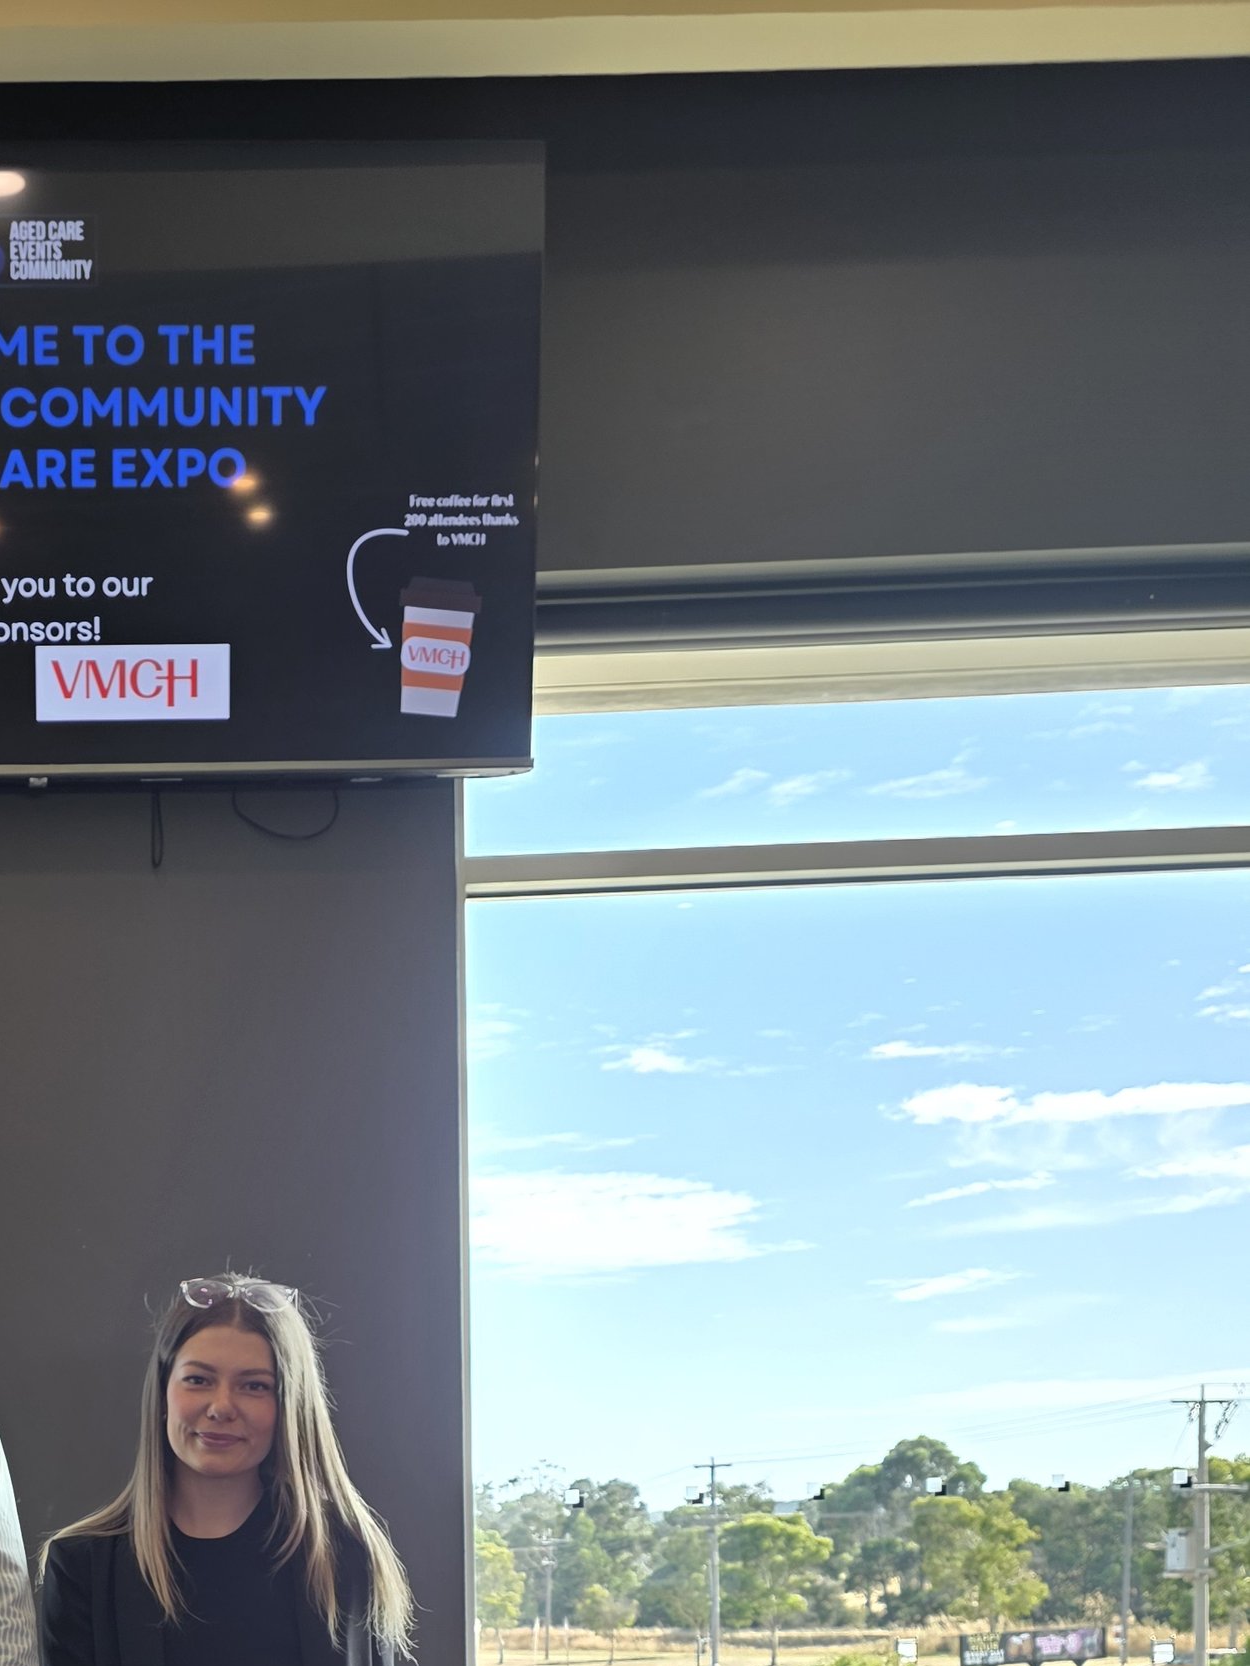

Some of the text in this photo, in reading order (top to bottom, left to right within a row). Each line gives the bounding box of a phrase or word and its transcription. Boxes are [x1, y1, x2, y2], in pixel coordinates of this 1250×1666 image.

[9, 220, 85, 241] AGED CARE
[10, 241, 62, 260] EVENTS
[10, 260, 92, 280] COMMUNITY
[72, 325, 144, 365] TO
[158, 324, 255, 365] THE
[0, 385, 327, 428] COMMUNITY
[112, 448, 247, 488] EXPO
[409, 494, 435, 508] Free
[436, 494, 471, 507] coffee
[472, 494, 490, 507] for
[404, 513, 519, 527] 200 attendees thanks
[437, 533, 486, 546] to VMCH
[1, 574, 55, 603] you
[62, 574, 95, 597] to
[102, 575, 153, 597] our
[409, 646, 465, 669] VMCH
[52, 659, 198, 707] VMCH
